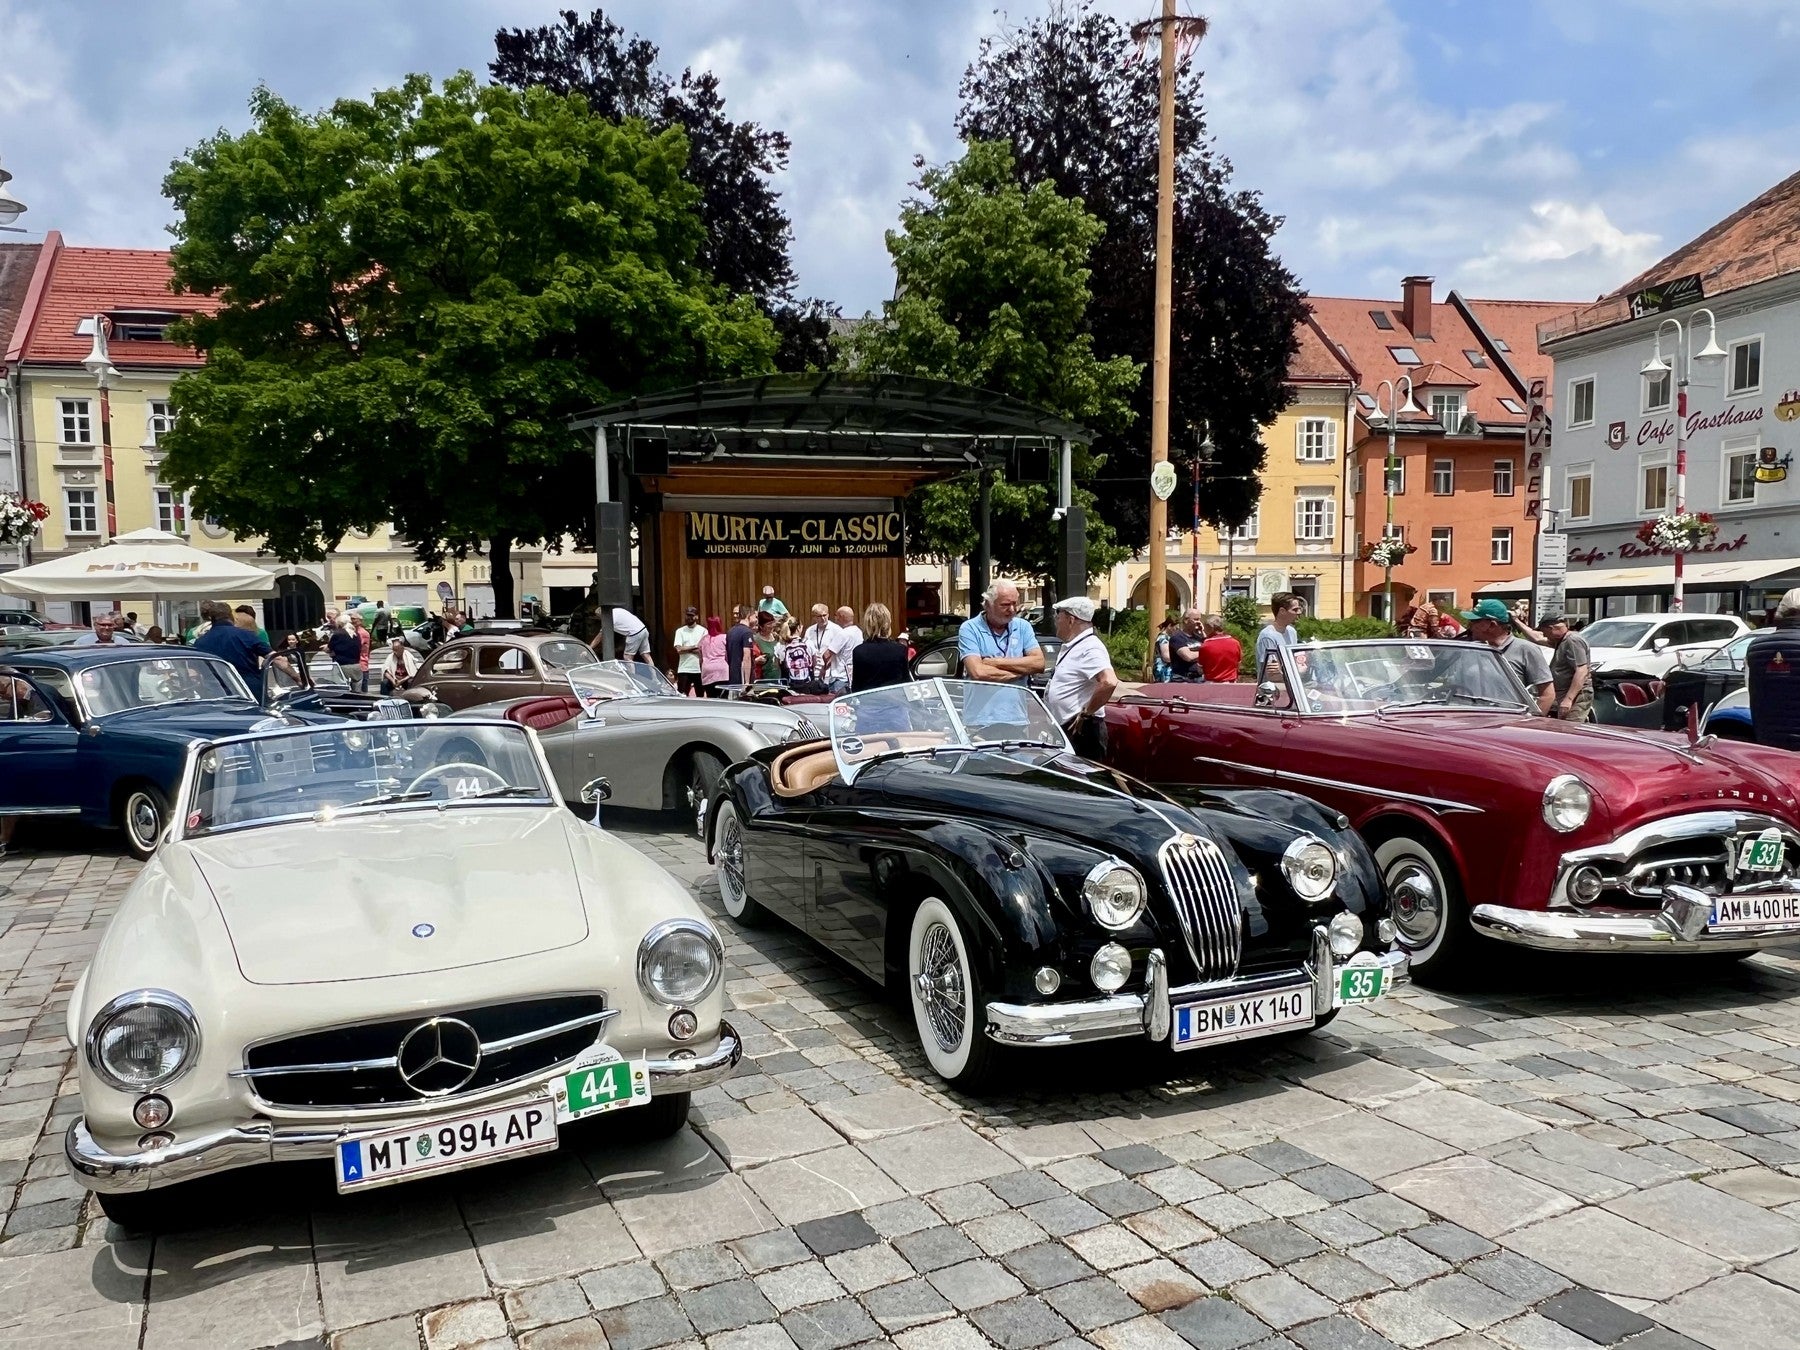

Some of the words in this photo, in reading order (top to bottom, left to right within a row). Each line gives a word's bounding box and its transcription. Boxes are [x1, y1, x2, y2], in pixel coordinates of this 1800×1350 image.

[1637, 419, 1674, 446] Cafe
[1685, 404, 1764, 440] Gasthaus
[690, 511, 900, 541] MURTAL-CLASSIC
[704, 544, 767, 554] JUDENBURG
[789, 545, 798, 553] 7.
[800, 544, 822, 553] JUNI
[829, 545, 841, 553] ab
[909, 683, 931, 700] 35
[455, 776, 482, 797] 44
[1756, 843, 1776, 865] 33
[1720, 900, 1742, 921] AM
[1753, 899, 1781, 920] 400
[1783, 898, 1800, 919] HE
[1348, 971, 1375, 997] 35
[1197, 1006, 1223, 1033] BN
[1240, 999, 1264, 1027] XK
[1269, 993, 1301, 1020] 140
[580, 1067, 618, 1103] 44
[348, 1165, 358, 1176] A
[369, 1136, 411, 1172] MT
[438, 1119, 498, 1157] 994
[505, 1109, 543, 1145] AP
